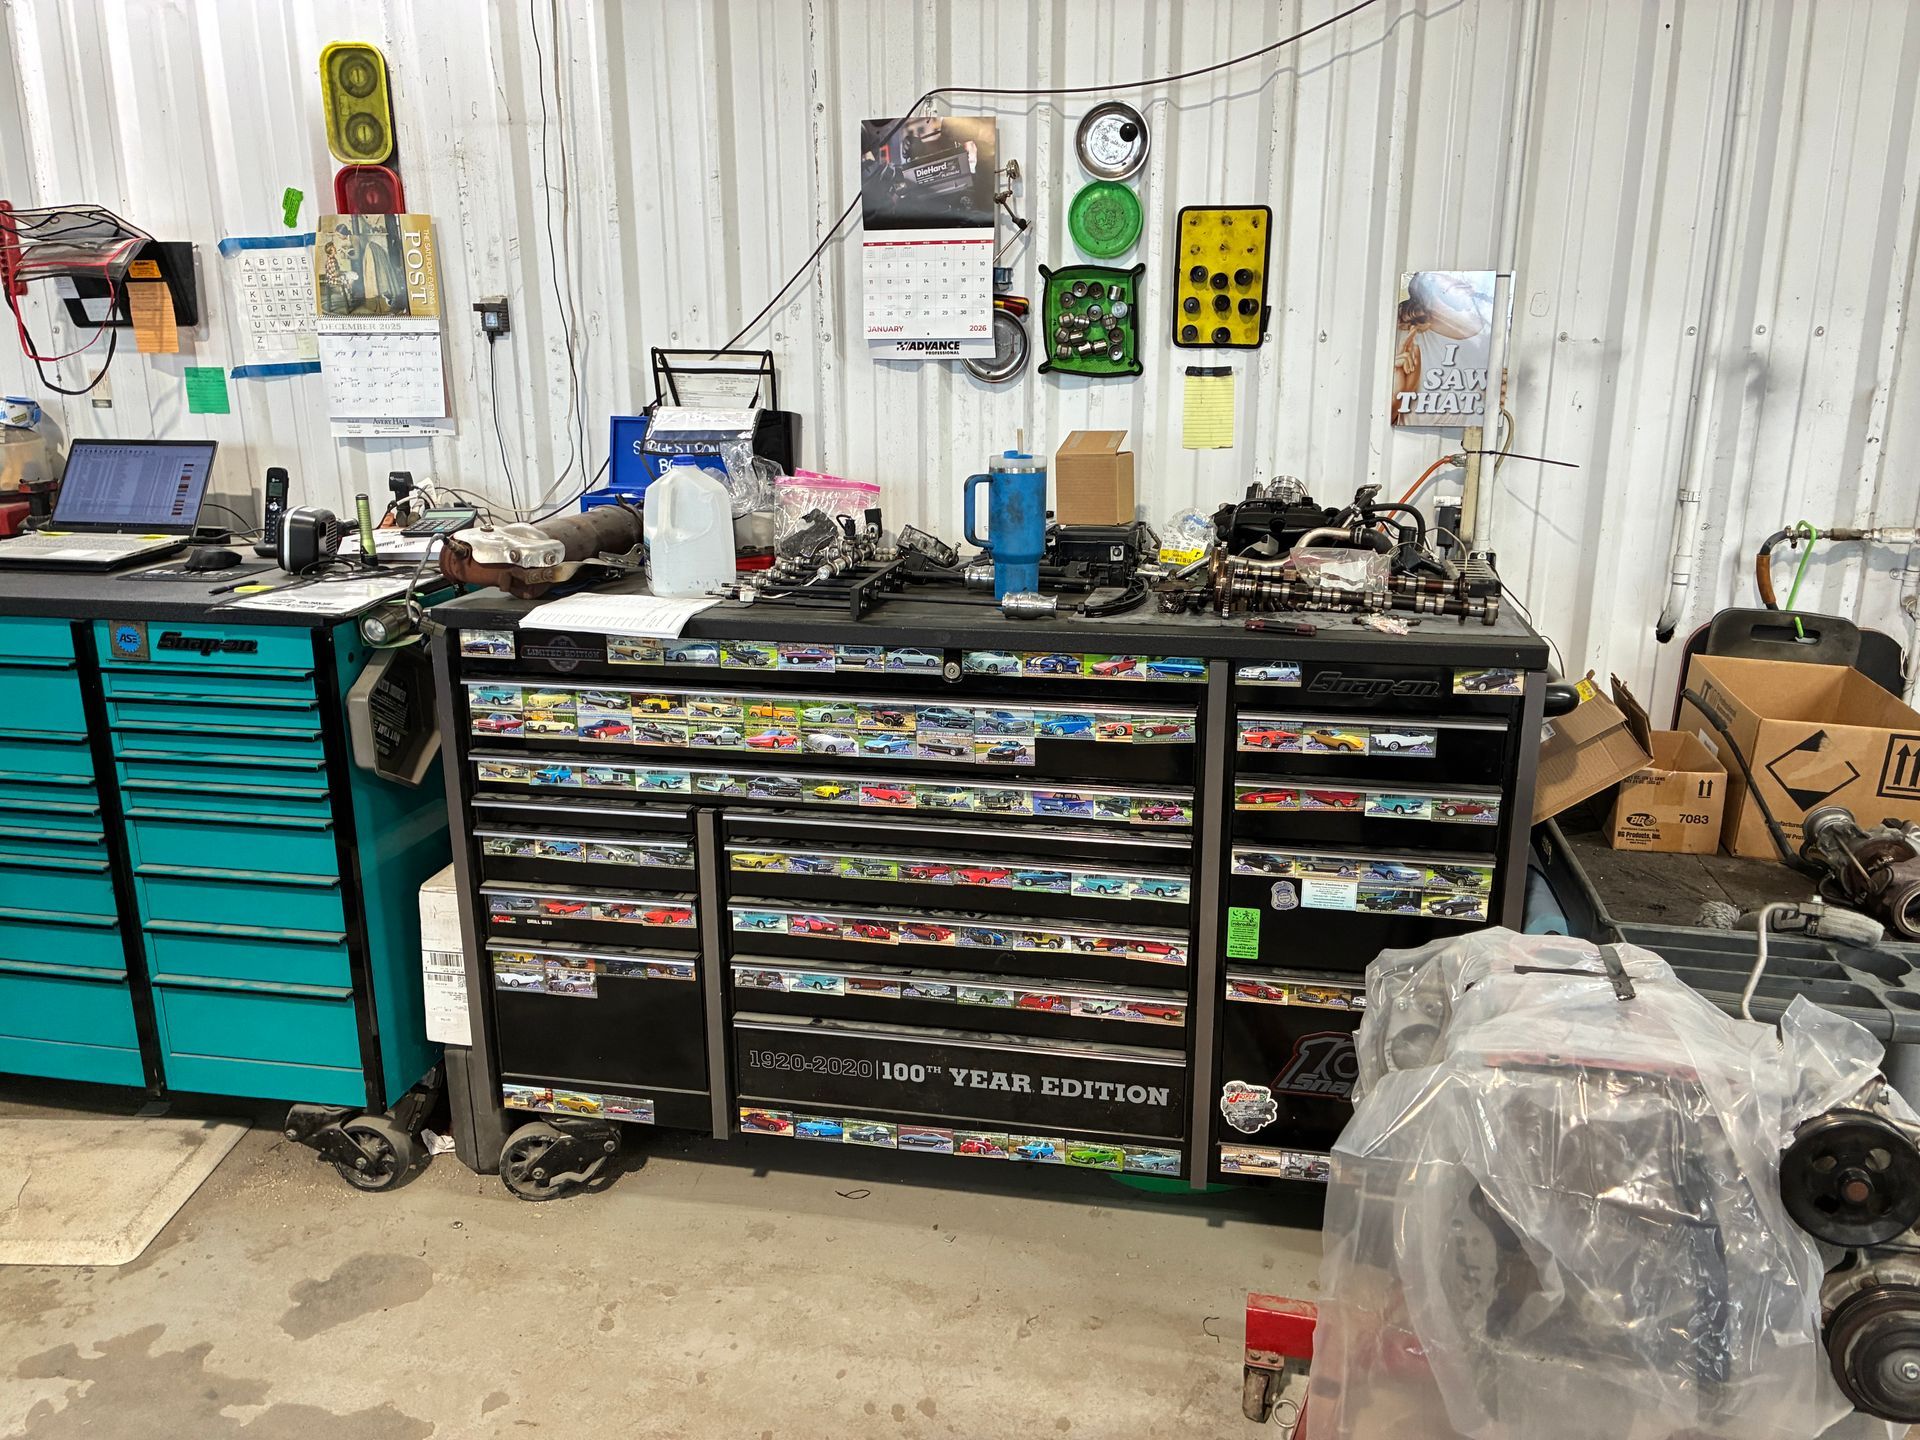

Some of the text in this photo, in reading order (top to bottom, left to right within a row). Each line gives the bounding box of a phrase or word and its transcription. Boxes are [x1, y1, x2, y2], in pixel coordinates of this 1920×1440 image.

[916, 162, 947, 177] DieHard
[404, 230, 428, 305] POST
[320, 323, 377, 331] DECEMBER
[867, 325, 904, 333] JANUARY
[908, 341, 960, 350] ADVANCE
[1441, 344, 1460, 367] I
[1423, 368, 1488, 391] SAW
[1396, 391, 1485, 415] THAT.
[392, 417, 408, 425] HALL
[119, 634, 138, 644] ASE
[157, 631, 258, 657] Snap-on
[526, 648, 600, 658] LIMITED EDITION
[1306, 671, 1441, 700] Snap-on
[1679, 813, 1710, 825] 7083
[1626, 831, 1651, 840] Products,
[749, 1049, 1170, 1106] 1920-2020 100TH YEAR EDITION
